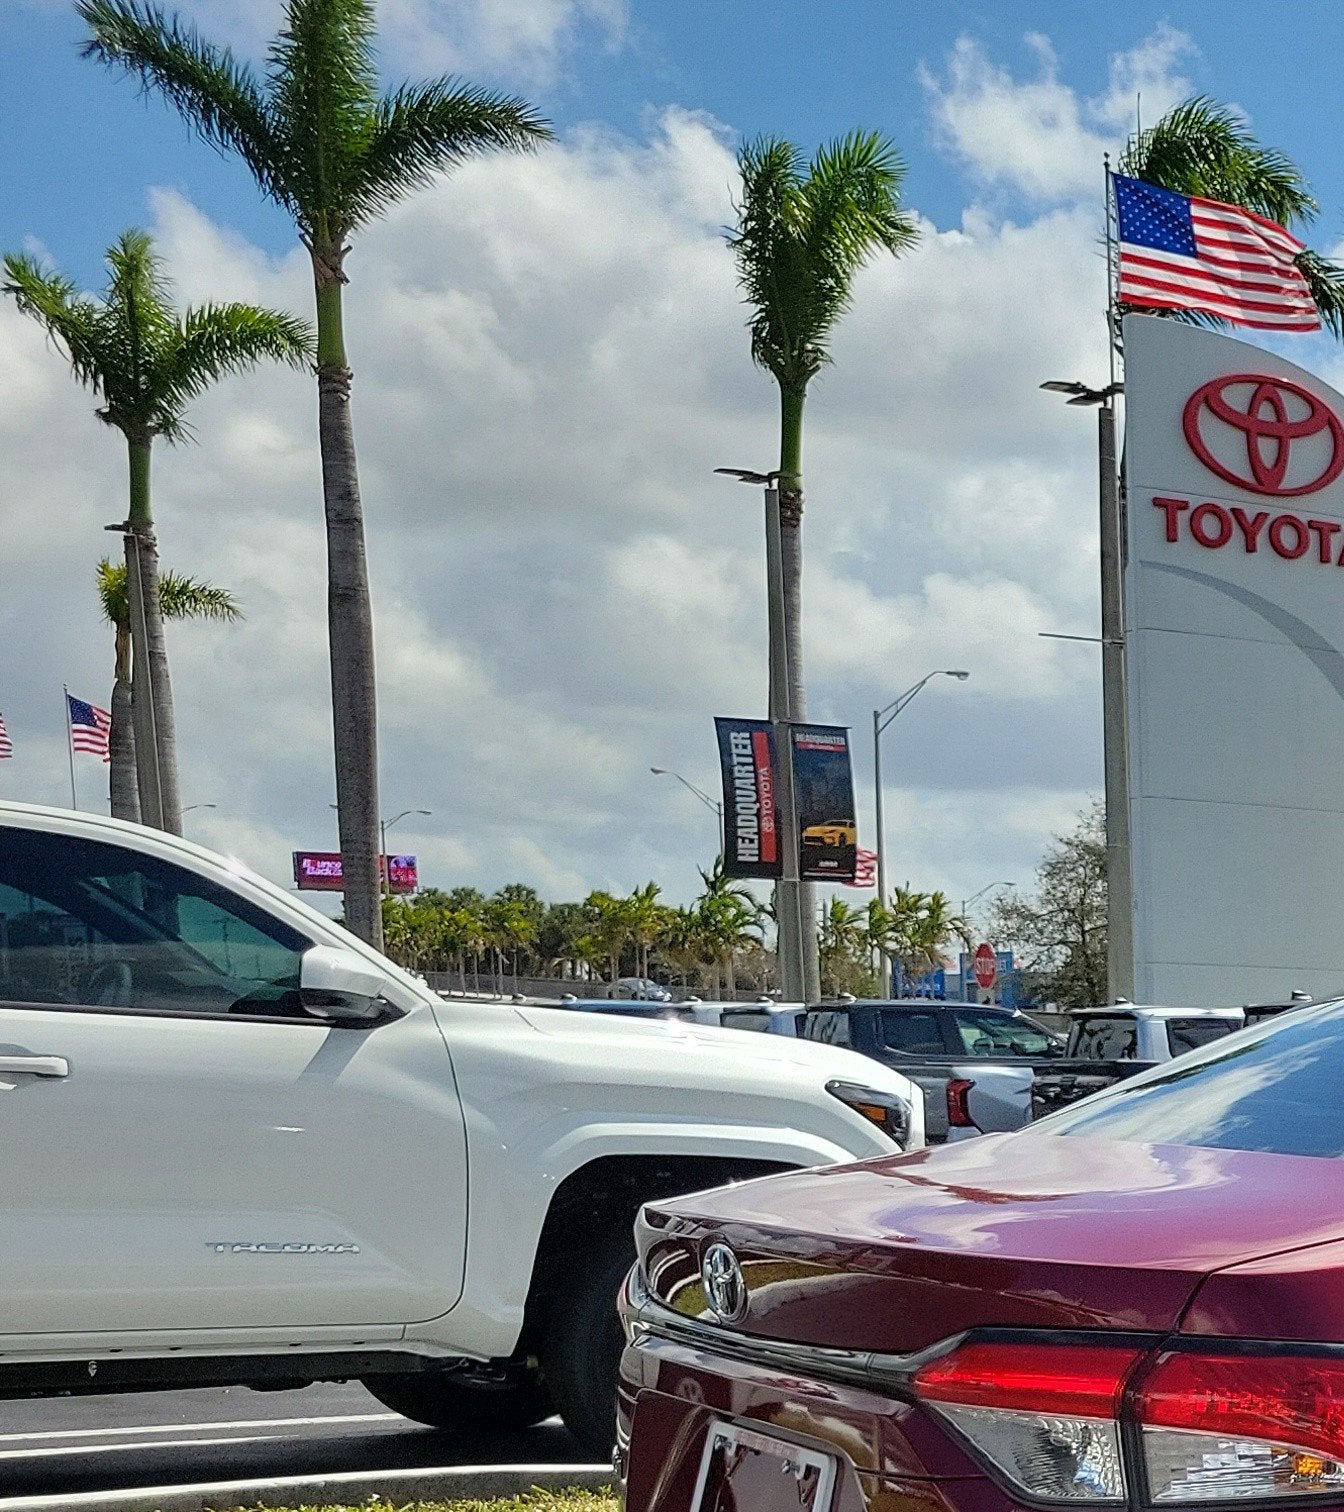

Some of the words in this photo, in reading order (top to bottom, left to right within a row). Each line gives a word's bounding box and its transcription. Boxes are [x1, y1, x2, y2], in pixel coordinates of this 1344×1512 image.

[730, 732, 760, 862] HEADQUARTER
[758, 767, 773, 817] TOYOTA
[976, 957, 996, 975] STOP
[205, 1242, 361, 1254] TACOMA
